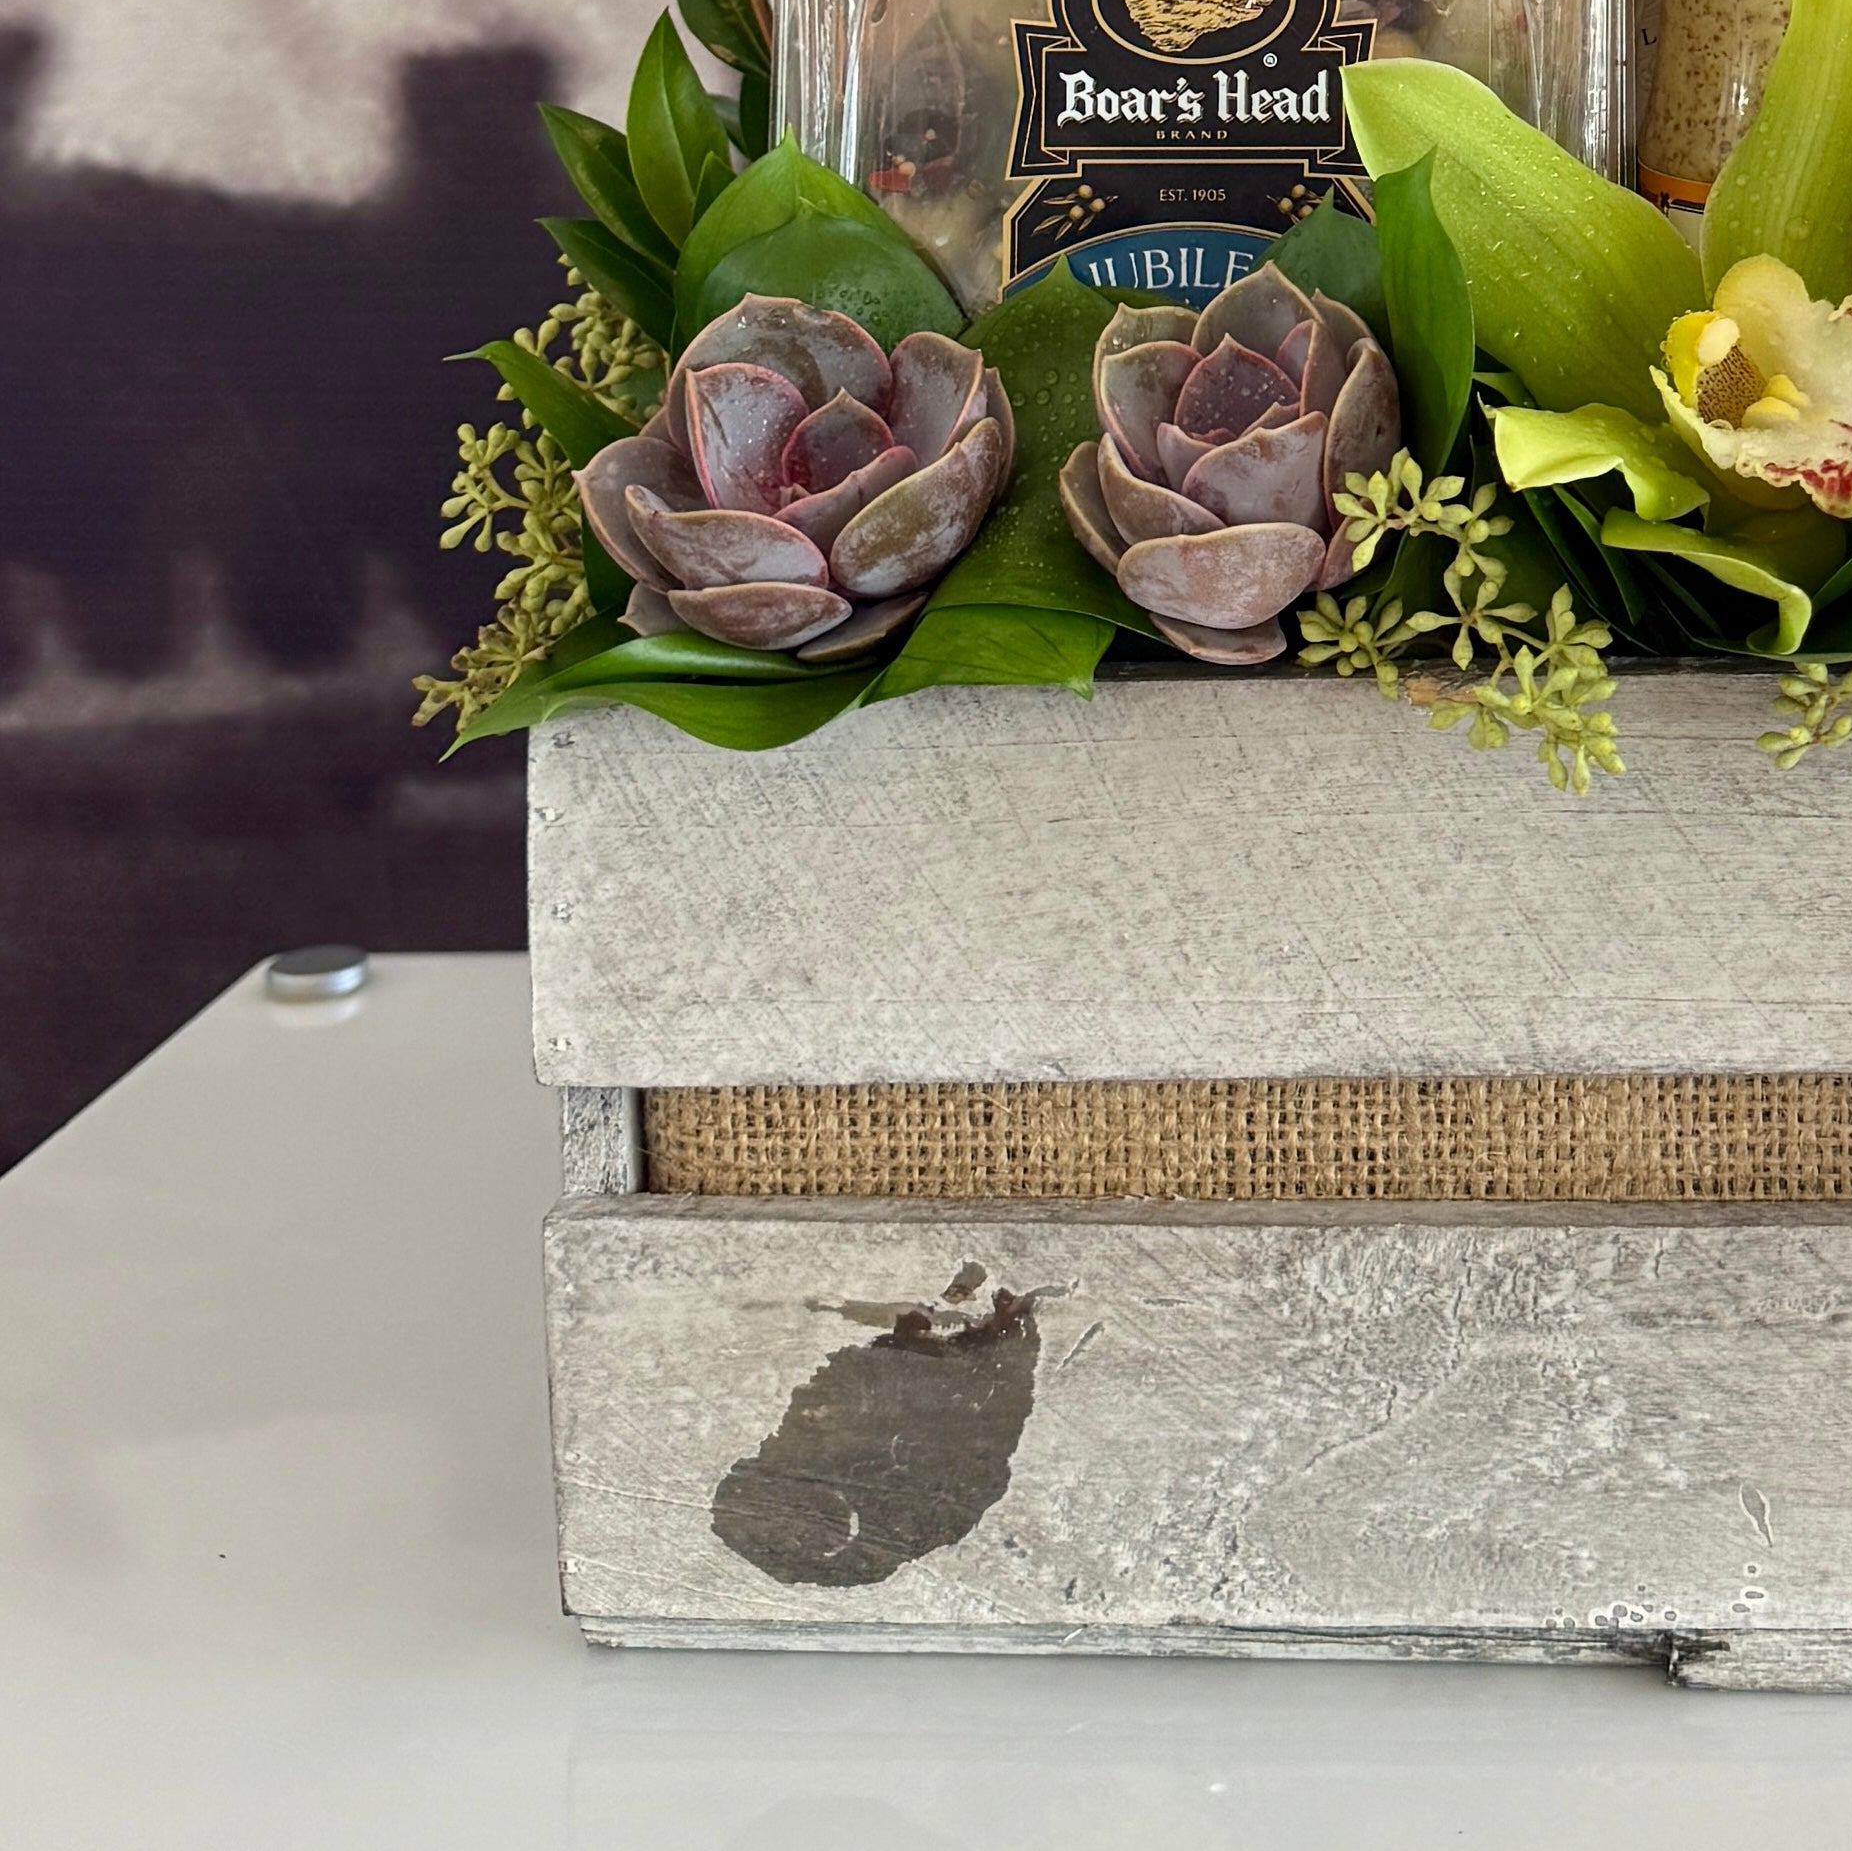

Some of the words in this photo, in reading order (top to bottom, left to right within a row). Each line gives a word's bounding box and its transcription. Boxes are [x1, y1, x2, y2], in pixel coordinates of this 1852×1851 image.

[1056, 68, 1206, 129] Boar's
[1212, 68, 1332, 125] Head
[1155, 129, 1229, 141] BRAND
[1159, 188, 1188, 202] EST.
[1192, 188, 1227, 202] 1905
